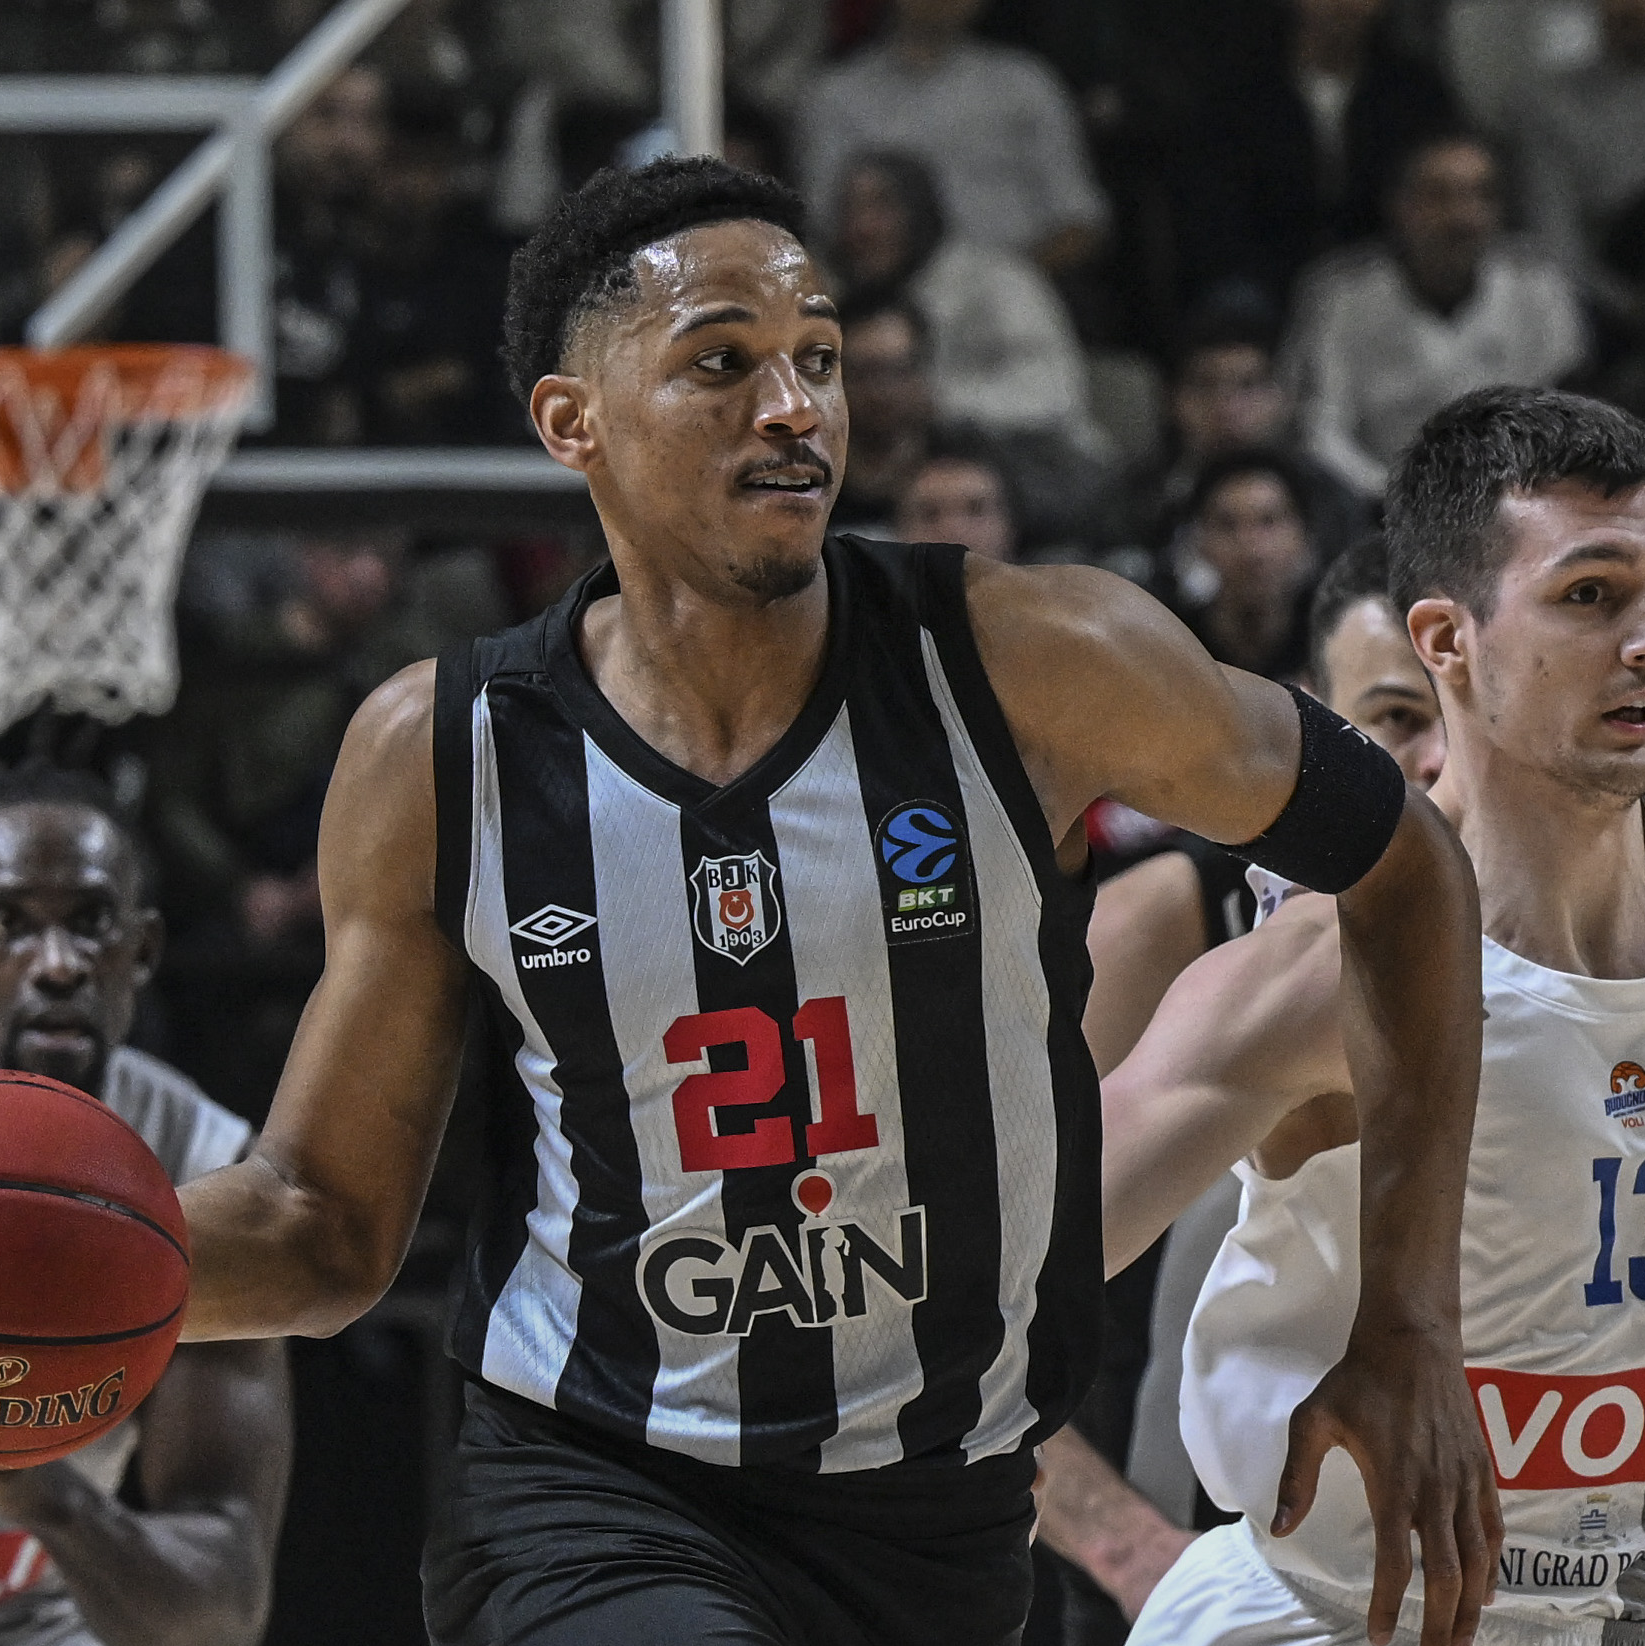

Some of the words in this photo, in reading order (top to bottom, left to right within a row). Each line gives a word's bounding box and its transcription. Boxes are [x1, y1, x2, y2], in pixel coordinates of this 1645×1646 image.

[708, 863, 759, 888] BJK
[899, 886, 954, 909] BKT
[891, 911, 966, 933] EuroCup
[719, 930, 763, 948] 1903
[521, 945, 591, 970] umbro
[662, 996, 879, 1173] 21
[1533, 1550, 1609, 1588] GRAD
